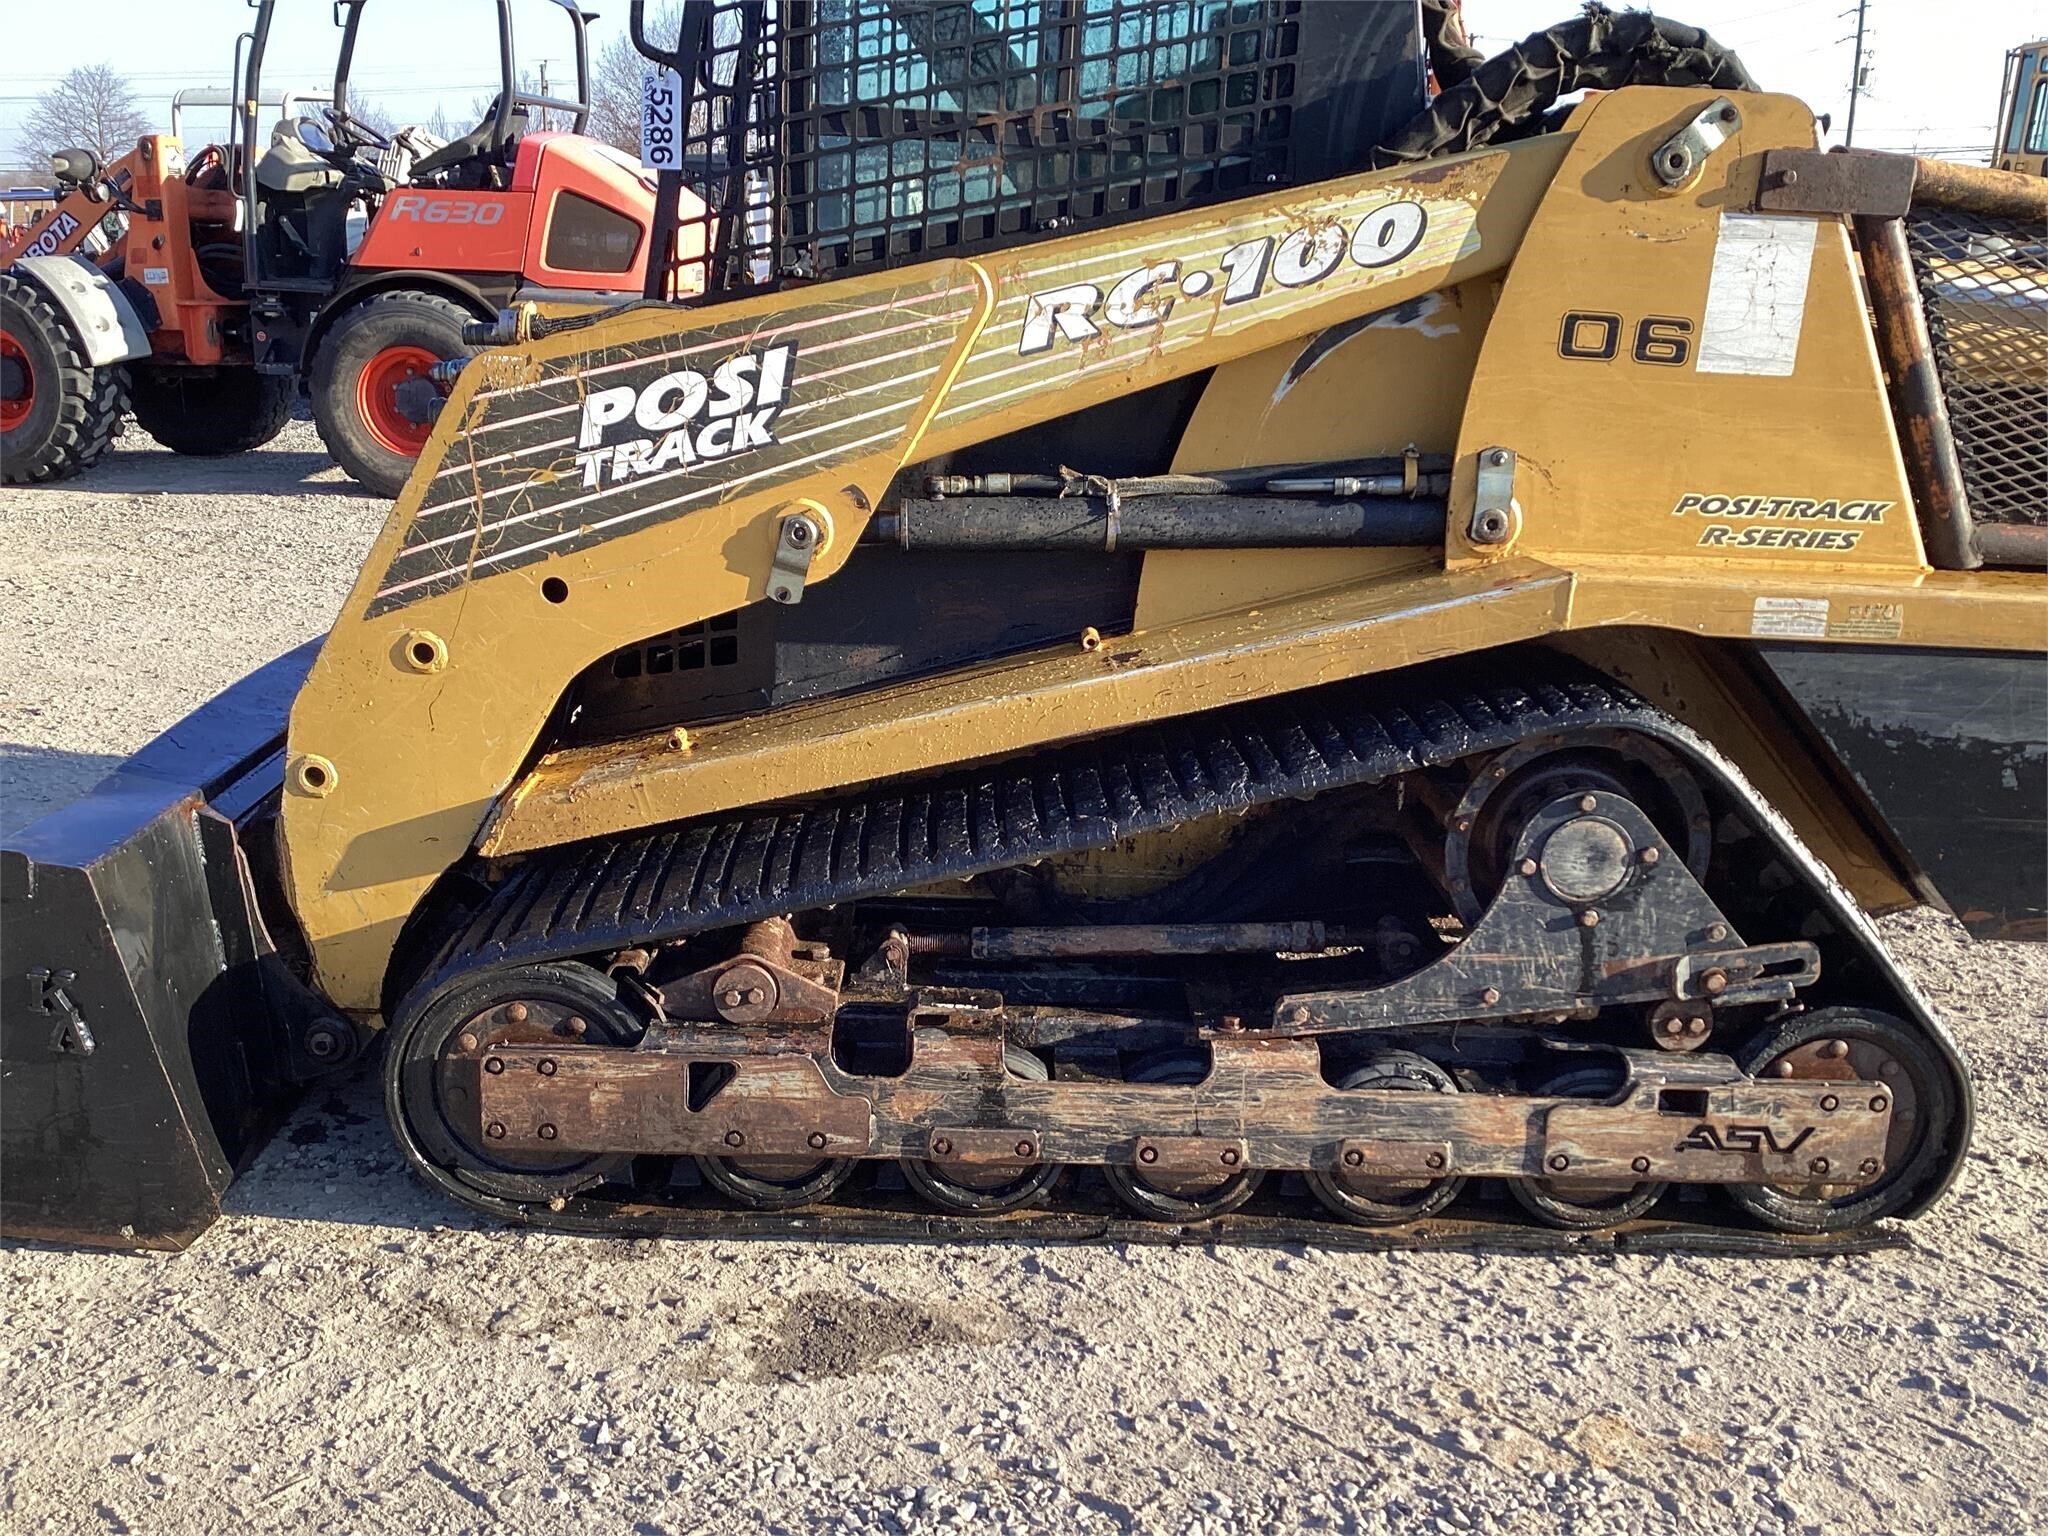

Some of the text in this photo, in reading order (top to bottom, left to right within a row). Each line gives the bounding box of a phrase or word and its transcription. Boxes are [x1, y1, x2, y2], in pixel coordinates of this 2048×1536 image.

[650, 87, 674, 164] 5286
[389, 195, 505, 225] R630
[10, 211, 80, 270] BOTA
[578, 344, 795, 449] POSI
[574, 406, 778, 488] TRACK
[1673, 493, 1896, 524] POSI-TRACK
[1697, 525, 1863, 551] R-SERIES
[1675, 1124, 1816, 1154] ASV
